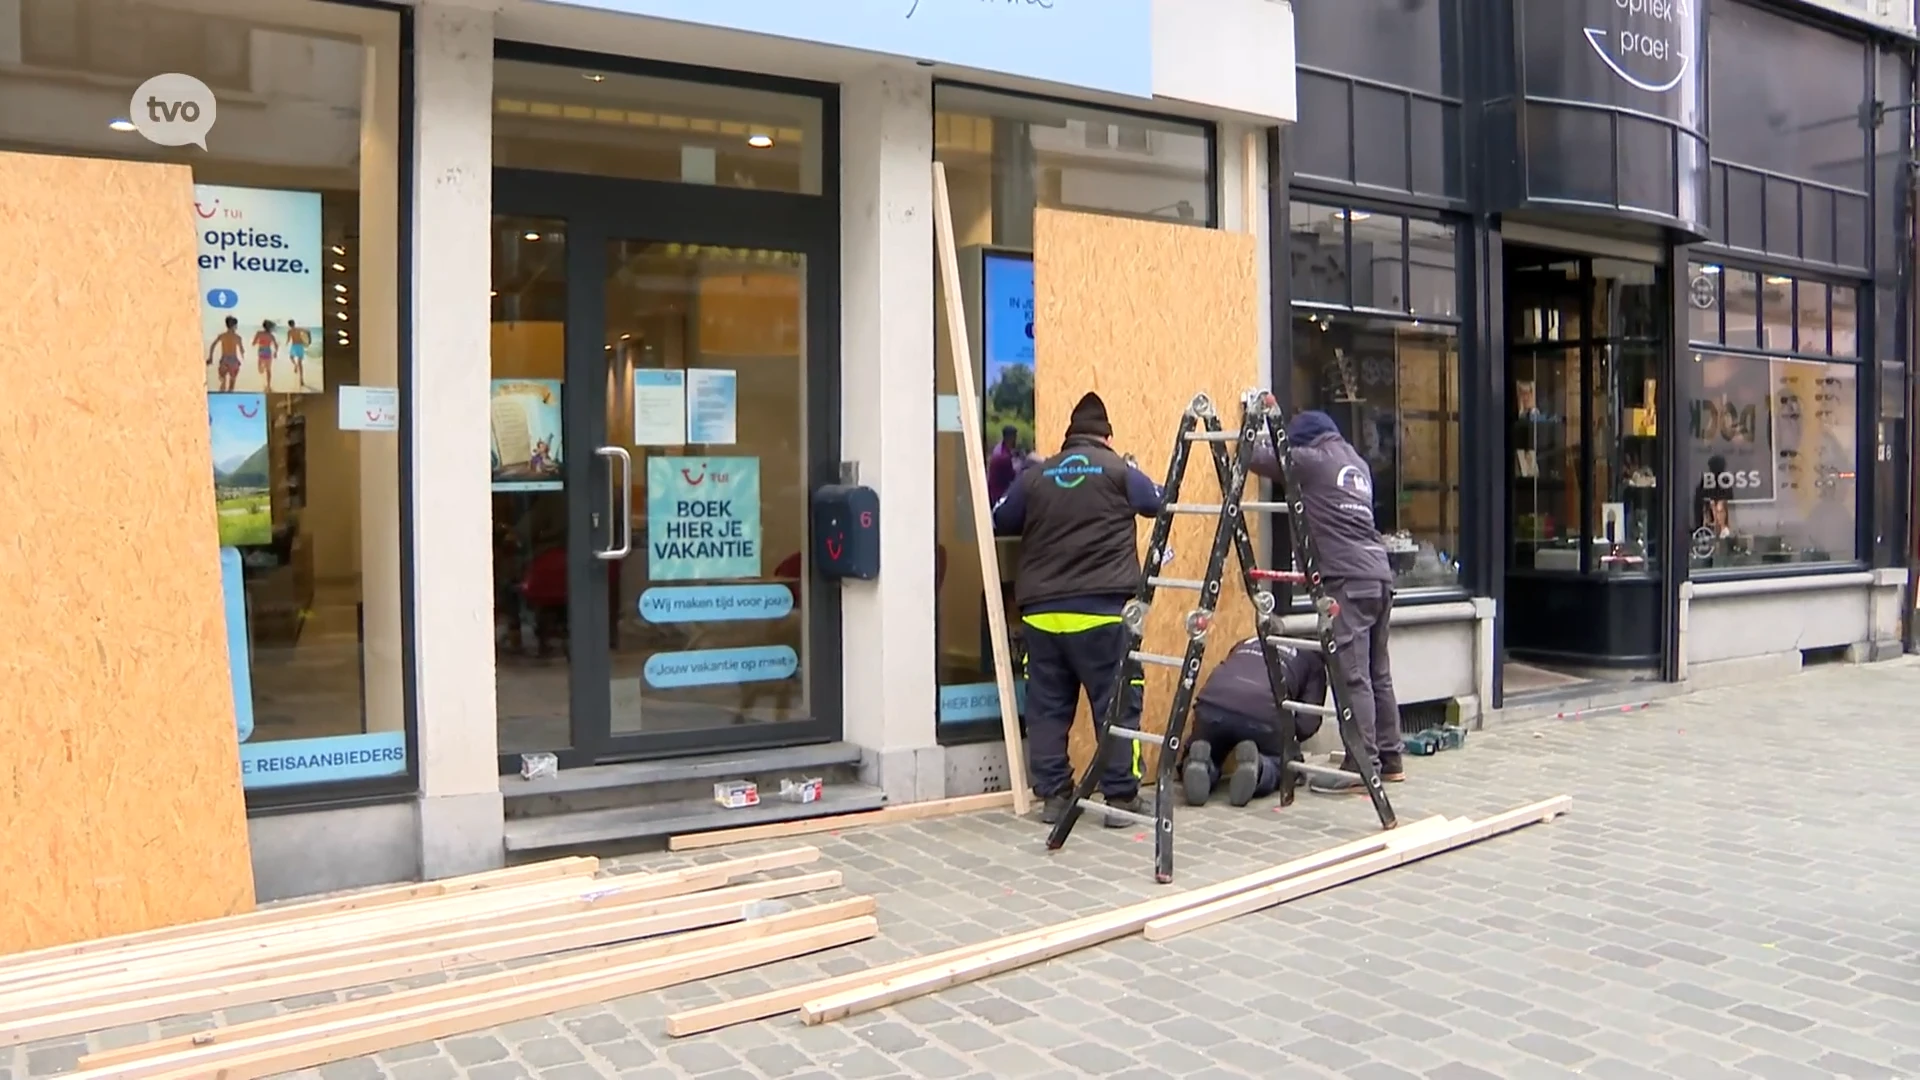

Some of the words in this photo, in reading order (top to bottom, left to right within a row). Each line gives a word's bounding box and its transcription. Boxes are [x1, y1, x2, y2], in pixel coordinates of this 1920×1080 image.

[1621, 31, 1670, 60] praet
[223, 208, 243, 219] TUI
[204, 227, 289, 250] opties.
[232, 251, 309, 274] keuze.
[710, 472, 729, 483] TUI
[1703, 471, 1762, 489] BOSS
[677, 500, 732, 518] BOEK
[860, 511, 872, 528] 6
[667, 521, 713, 538] HIER
[718, 520, 742, 538] JE
[654, 540, 754, 560] VAKANTIE
[652, 598, 671, 612] Wij
[674, 597, 713, 609] maken
[716, 596, 734, 610] tijd
[737, 599, 760, 608] voor
[763, 597, 782, 609] jou
[656, 664, 688, 676] Jouw
[690, 660, 738, 673] vakantie
[741, 660, 756, 670] op
[759, 656, 787, 667] maat
[257, 747, 404, 773] REISAANBIEDERS
